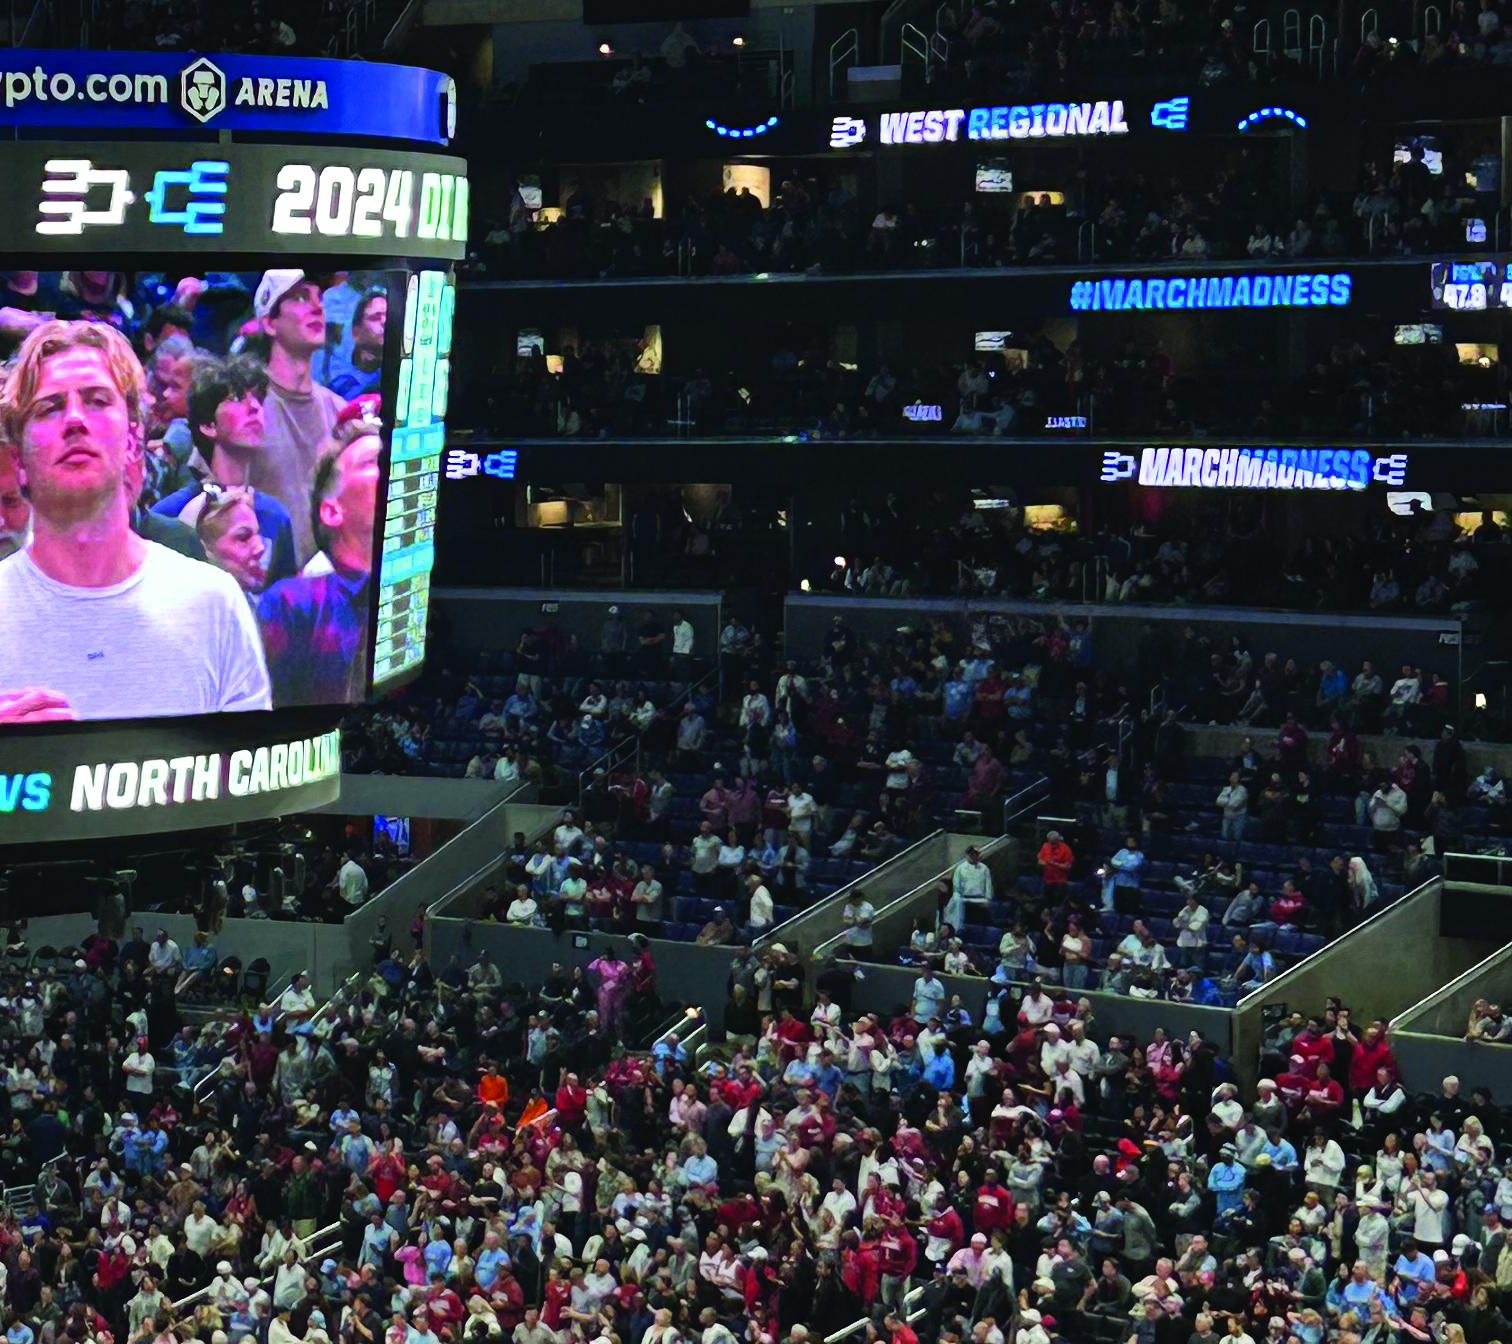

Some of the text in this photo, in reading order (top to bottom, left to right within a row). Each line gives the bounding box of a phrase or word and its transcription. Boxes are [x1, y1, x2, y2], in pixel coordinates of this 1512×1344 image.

[235, 77, 329, 110] ARENA
[878, 100, 1130, 145] WEST REGIONAL
[272, 164, 412, 237] 2024
[1070, 273, 1351, 312] #MARCHMADNESS
[1138, 447, 1371, 489] MARCHMADNESS
[69, 750, 220, 811] NORTH
